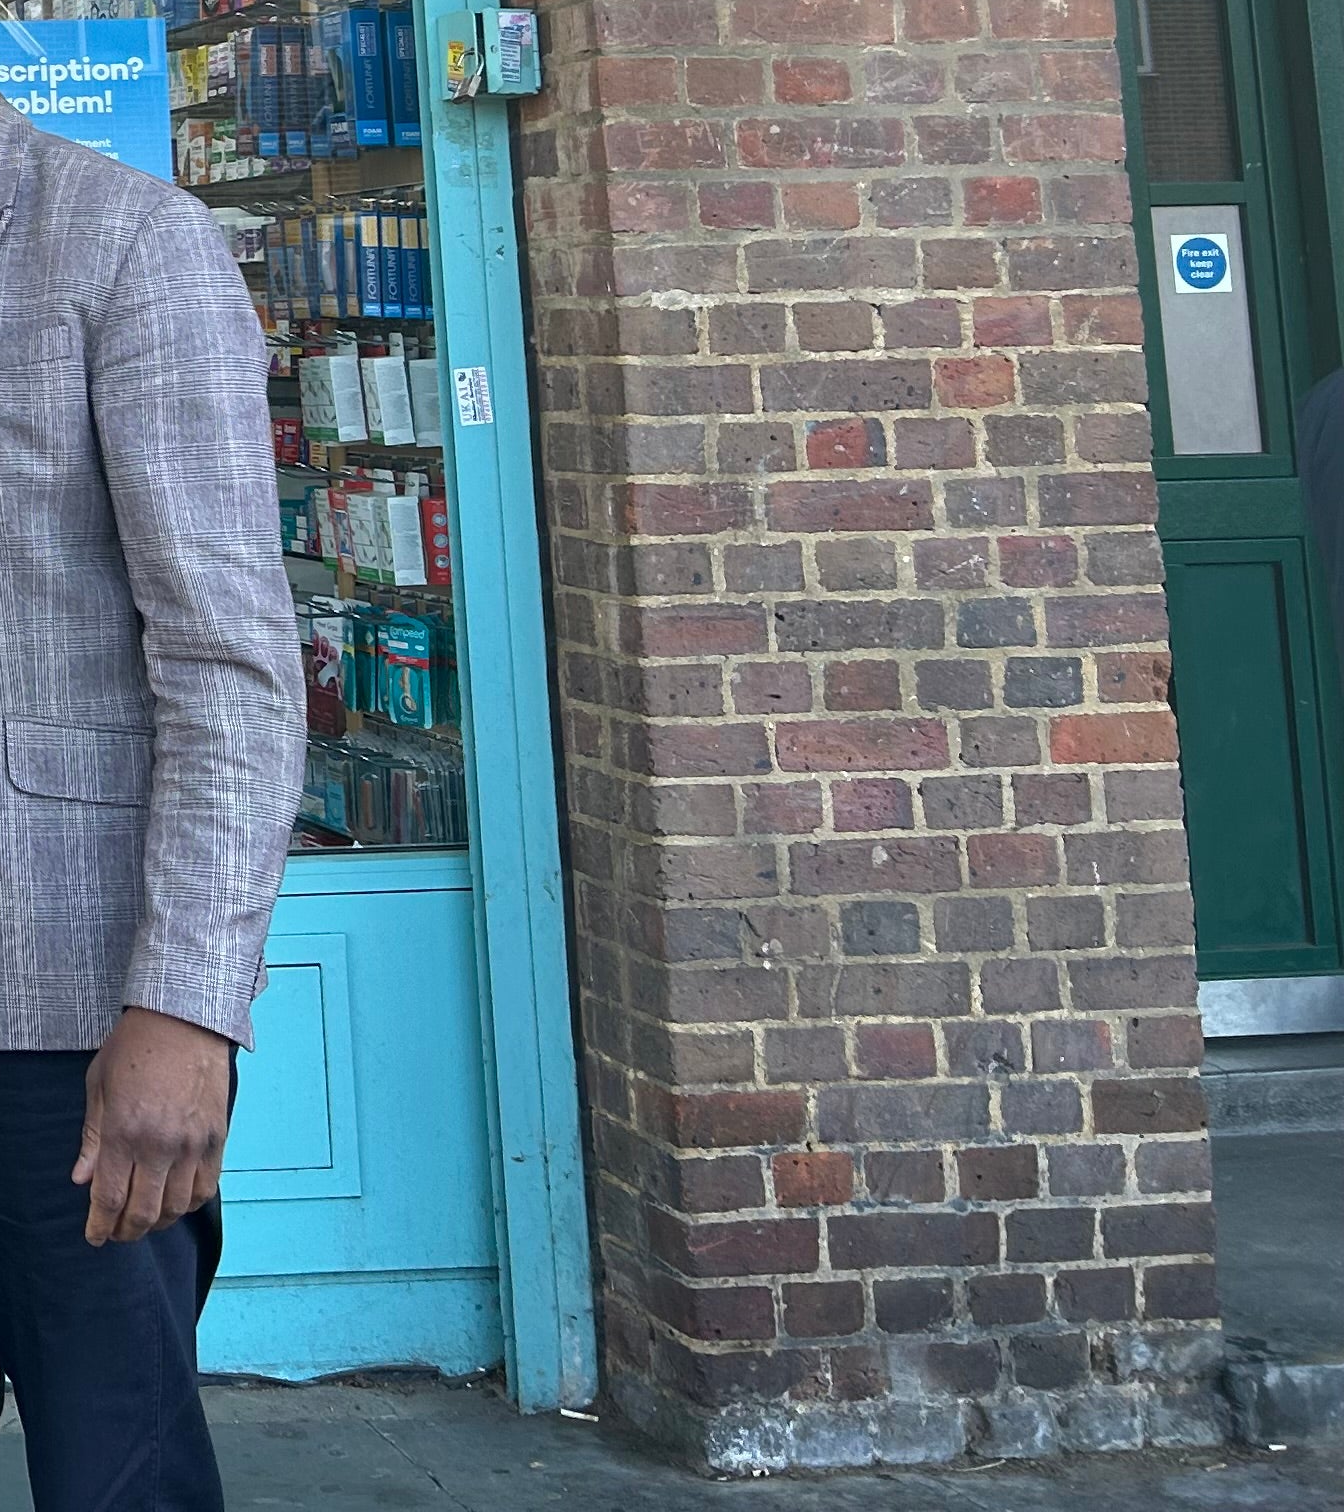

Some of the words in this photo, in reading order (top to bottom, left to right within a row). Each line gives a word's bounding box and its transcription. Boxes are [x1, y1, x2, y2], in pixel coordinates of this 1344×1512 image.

[1182, 248, 1200, 257] Fire
[1202, 248, 1220, 257] exit
[1189, 259, 1214, 268] keep
[1190, 270, 1214, 279] clear
